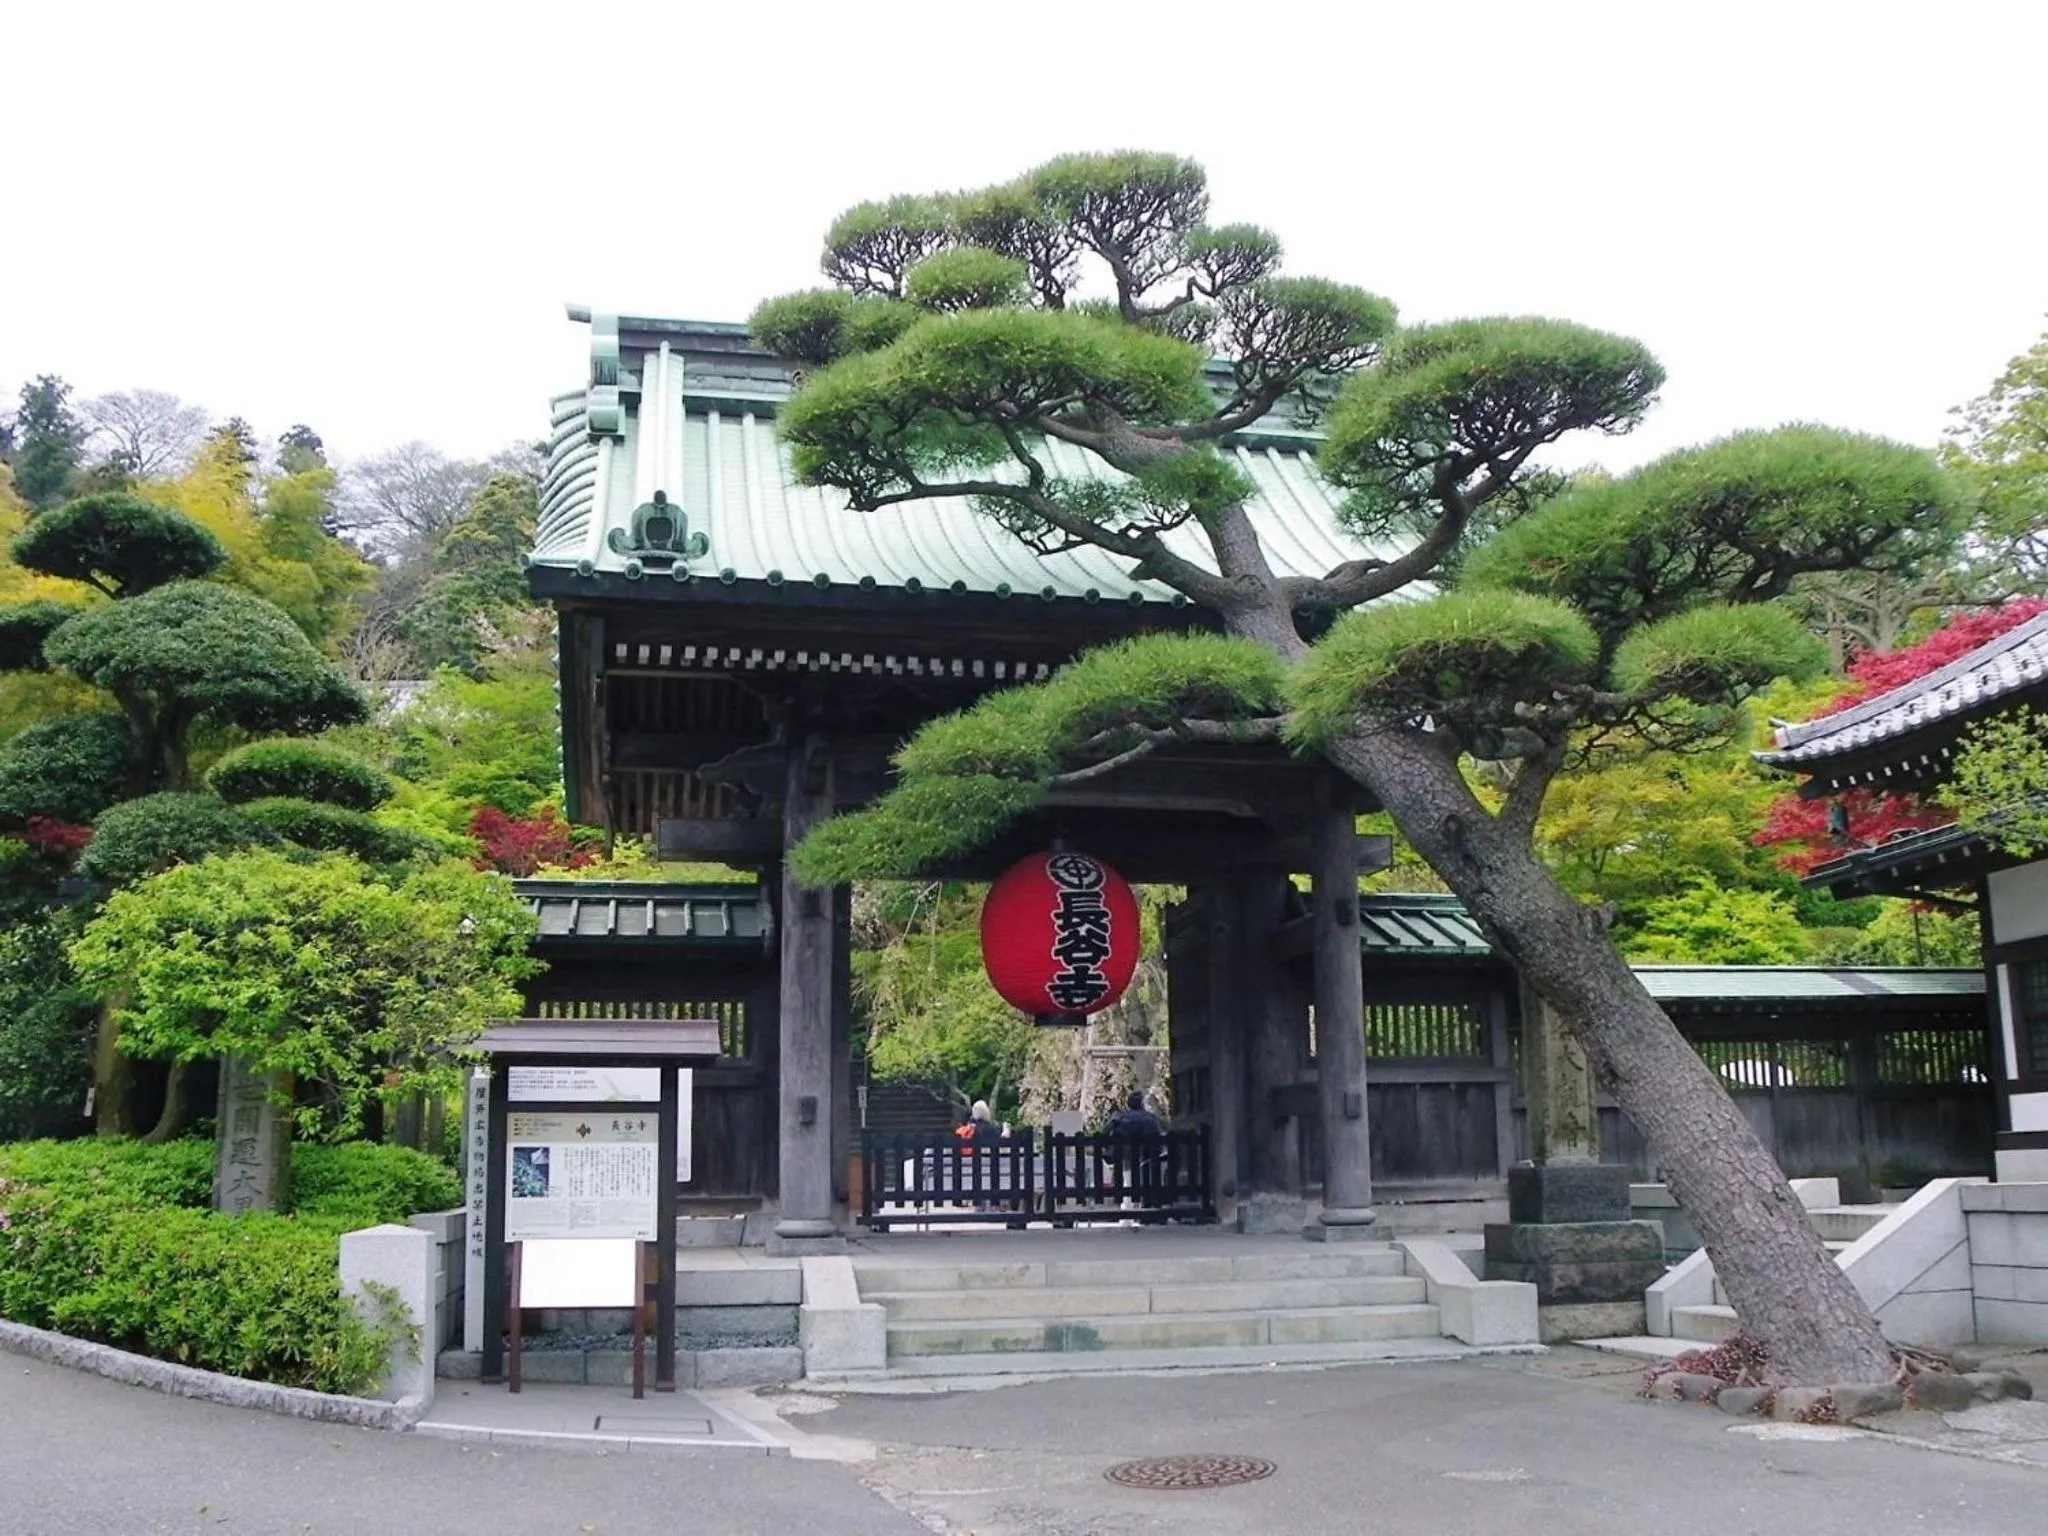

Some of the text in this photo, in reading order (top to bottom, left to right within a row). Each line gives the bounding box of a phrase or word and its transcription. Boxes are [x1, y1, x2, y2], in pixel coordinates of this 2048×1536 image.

[1046, 890, 1111, 1009] 長谷寺
[611, 1120, 646, 1132] 長谷寺
